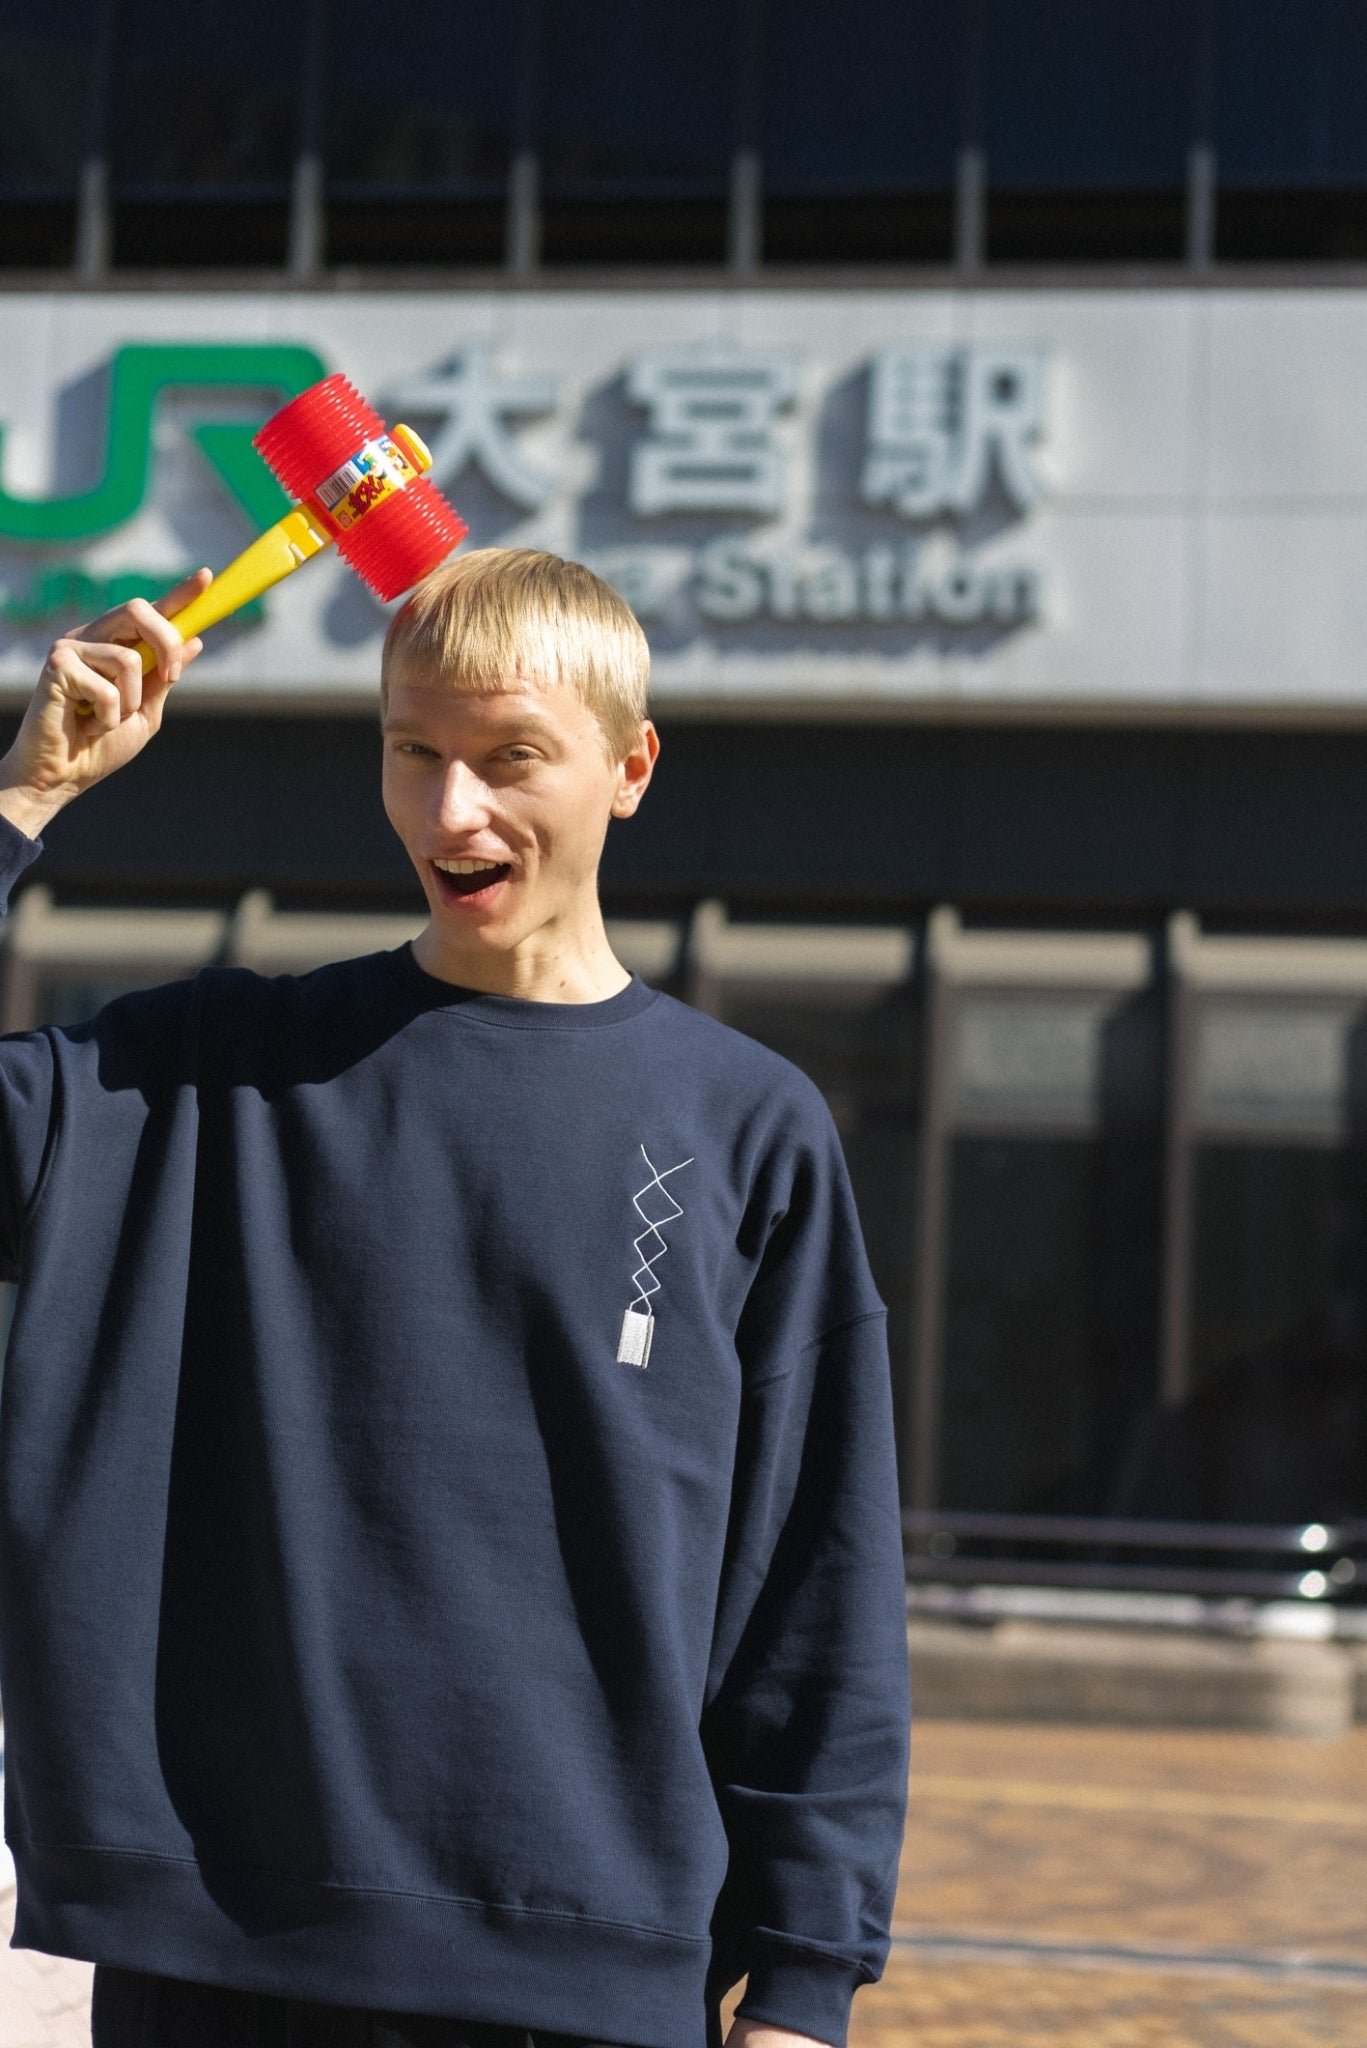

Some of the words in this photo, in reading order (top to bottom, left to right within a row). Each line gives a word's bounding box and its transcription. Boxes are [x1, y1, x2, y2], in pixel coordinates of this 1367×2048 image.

[0, 343, 328, 540] JR
[384, 340, 1050, 516] 大宮駅
[697, 535, 1040, 621] Station
